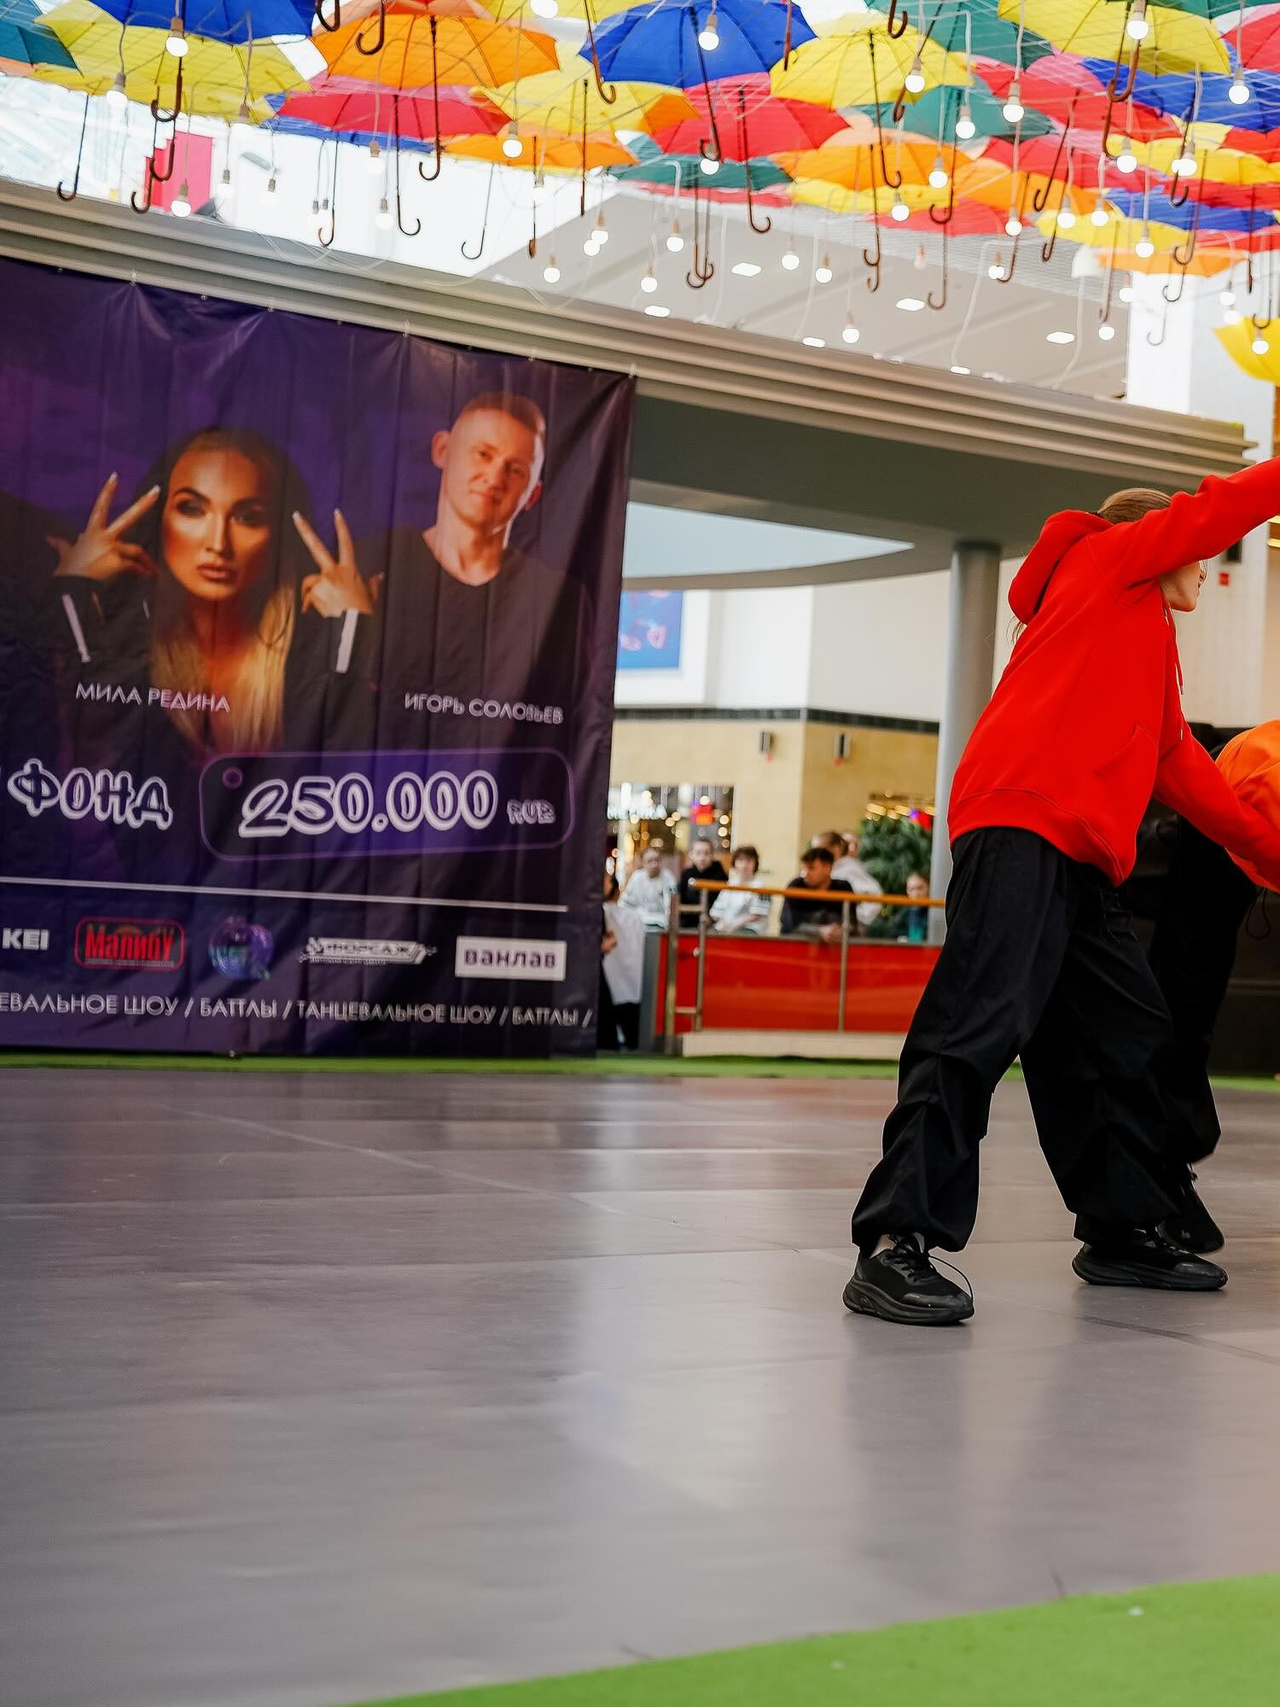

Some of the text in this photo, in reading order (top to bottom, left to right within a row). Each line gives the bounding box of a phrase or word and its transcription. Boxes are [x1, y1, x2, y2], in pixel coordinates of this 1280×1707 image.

[75, 681, 231, 713] МИЛА РЕДИНА
[404, 692, 564, 725] ИГОРЬ СОЛОВЬЕВ
[238, 770, 556, 838] 250.000 RUB
[85, 924, 175, 961] Малибу
[463, 948, 557, 969] ванлав
[124, 996, 178, 1017] ШОУ
[200, 997, 277, 1018] БАТТЛЫ
[297, 1001, 447, 1024] ТАНЦЕВАЛЬНОЕ
[450, 1005, 497, 1024] ШОУ
[512, 1006, 578, 1026] БАТТЛЫ
